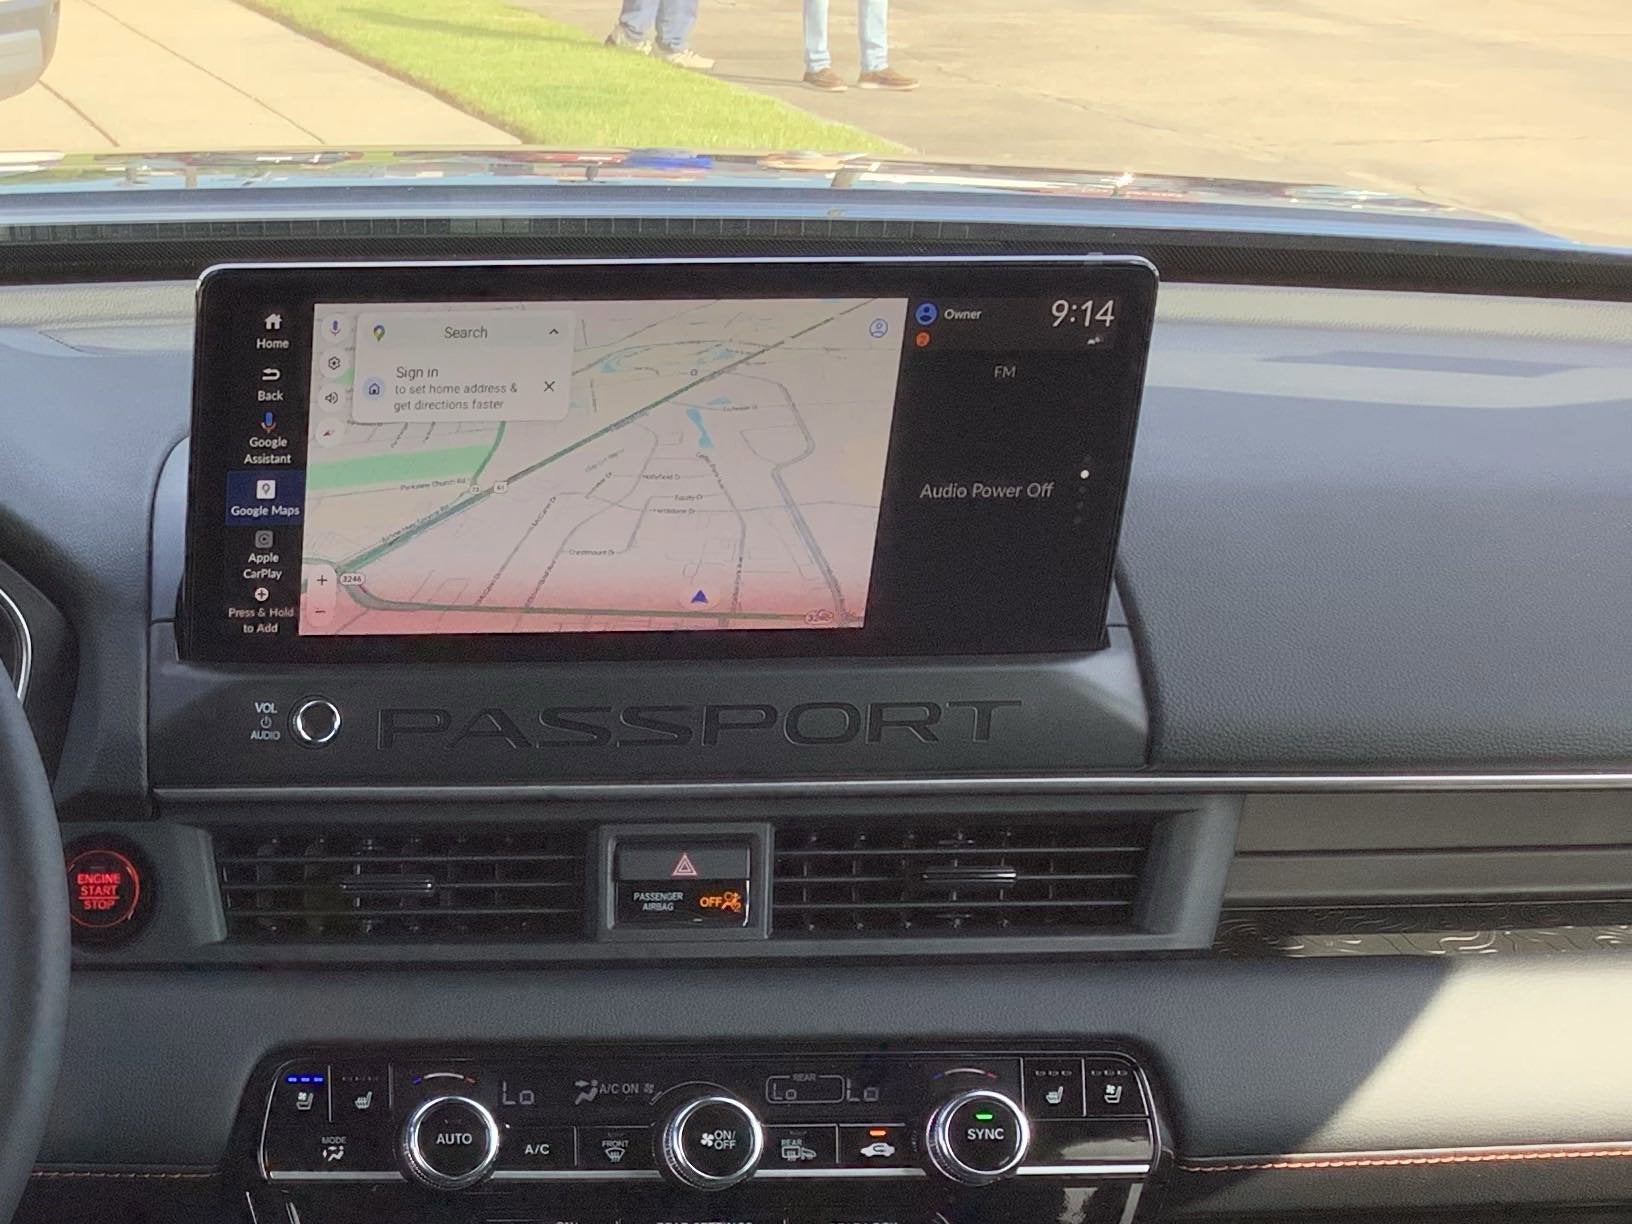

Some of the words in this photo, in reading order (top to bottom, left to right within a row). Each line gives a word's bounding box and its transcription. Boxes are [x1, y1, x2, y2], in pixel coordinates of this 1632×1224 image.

[944, 308, 982, 320] Owner
[1051, 299, 1115, 328] 9:14
[444, 326, 489, 340] Search
[256, 338, 289, 349] Home
[395, 366, 423, 381] Sign
[426, 367, 439, 378] in
[994, 365, 1017, 378] FM
[395, 384, 406, 395] to
[409, 384, 426, 395] set
[429, 383, 460, 394] home
[463, 383, 507, 394] address
[509, 382, 518, 394] &
[257, 390, 283, 401] Back
[393, 400, 412, 412] get
[414, 399, 469, 410] directions
[471, 399, 504, 410] faster
[249, 437, 288, 450] Google
[244, 453, 291, 464] Assistant
[920, 483, 967, 498] Audio
[972, 483, 1023, 498] Power
[1026, 482, 1055, 498] Off
[231, 504, 269, 518] Google
[271, 505, 300, 519] Maps
[248, 552, 280, 565] Apple
[243, 568, 283, 582] CarPlay
[342, 574, 363, 584] 3246
[228, 607, 255, 618] Press
[257, 608, 266, 618] &
[269, 607, 294, 618] Hold
[243, 624, 253, 634] to
[255, 623, 278, 633] Add
[255, 702, 278, 714] VOL
[377, 701, 1023, 750] PASSPORT
[250, 730, 280, 741] AUDIO
[77, 873, 121, 885] ENGINE
[80, 885, 117, 896] START
[633, 891, 684, 901] PASSENGER
[84, 900, 115, 910] STOP
[642, 902, 675, 912] AIRBAG
[699, 896, 723, 908] OFF
[792, 1073, 817, 1082] REAR
[599, 1083, 619, 1094] A/C
[622, 1083, 639, 1094] ON
[436, 1132, 473, 1145] AUTO
[714, 1130, 736, 1140] ON/
[967, 1128, 1005, 1140] SYNC
[321, 1136, 347, 1145] MODE
[602, 1140, 629, 1148] FRONT
[714, 1139, 736, 1150] OFF
[781, 1138, 802, 1146] REAR
[525, 1143, 550, 1155] A/C
